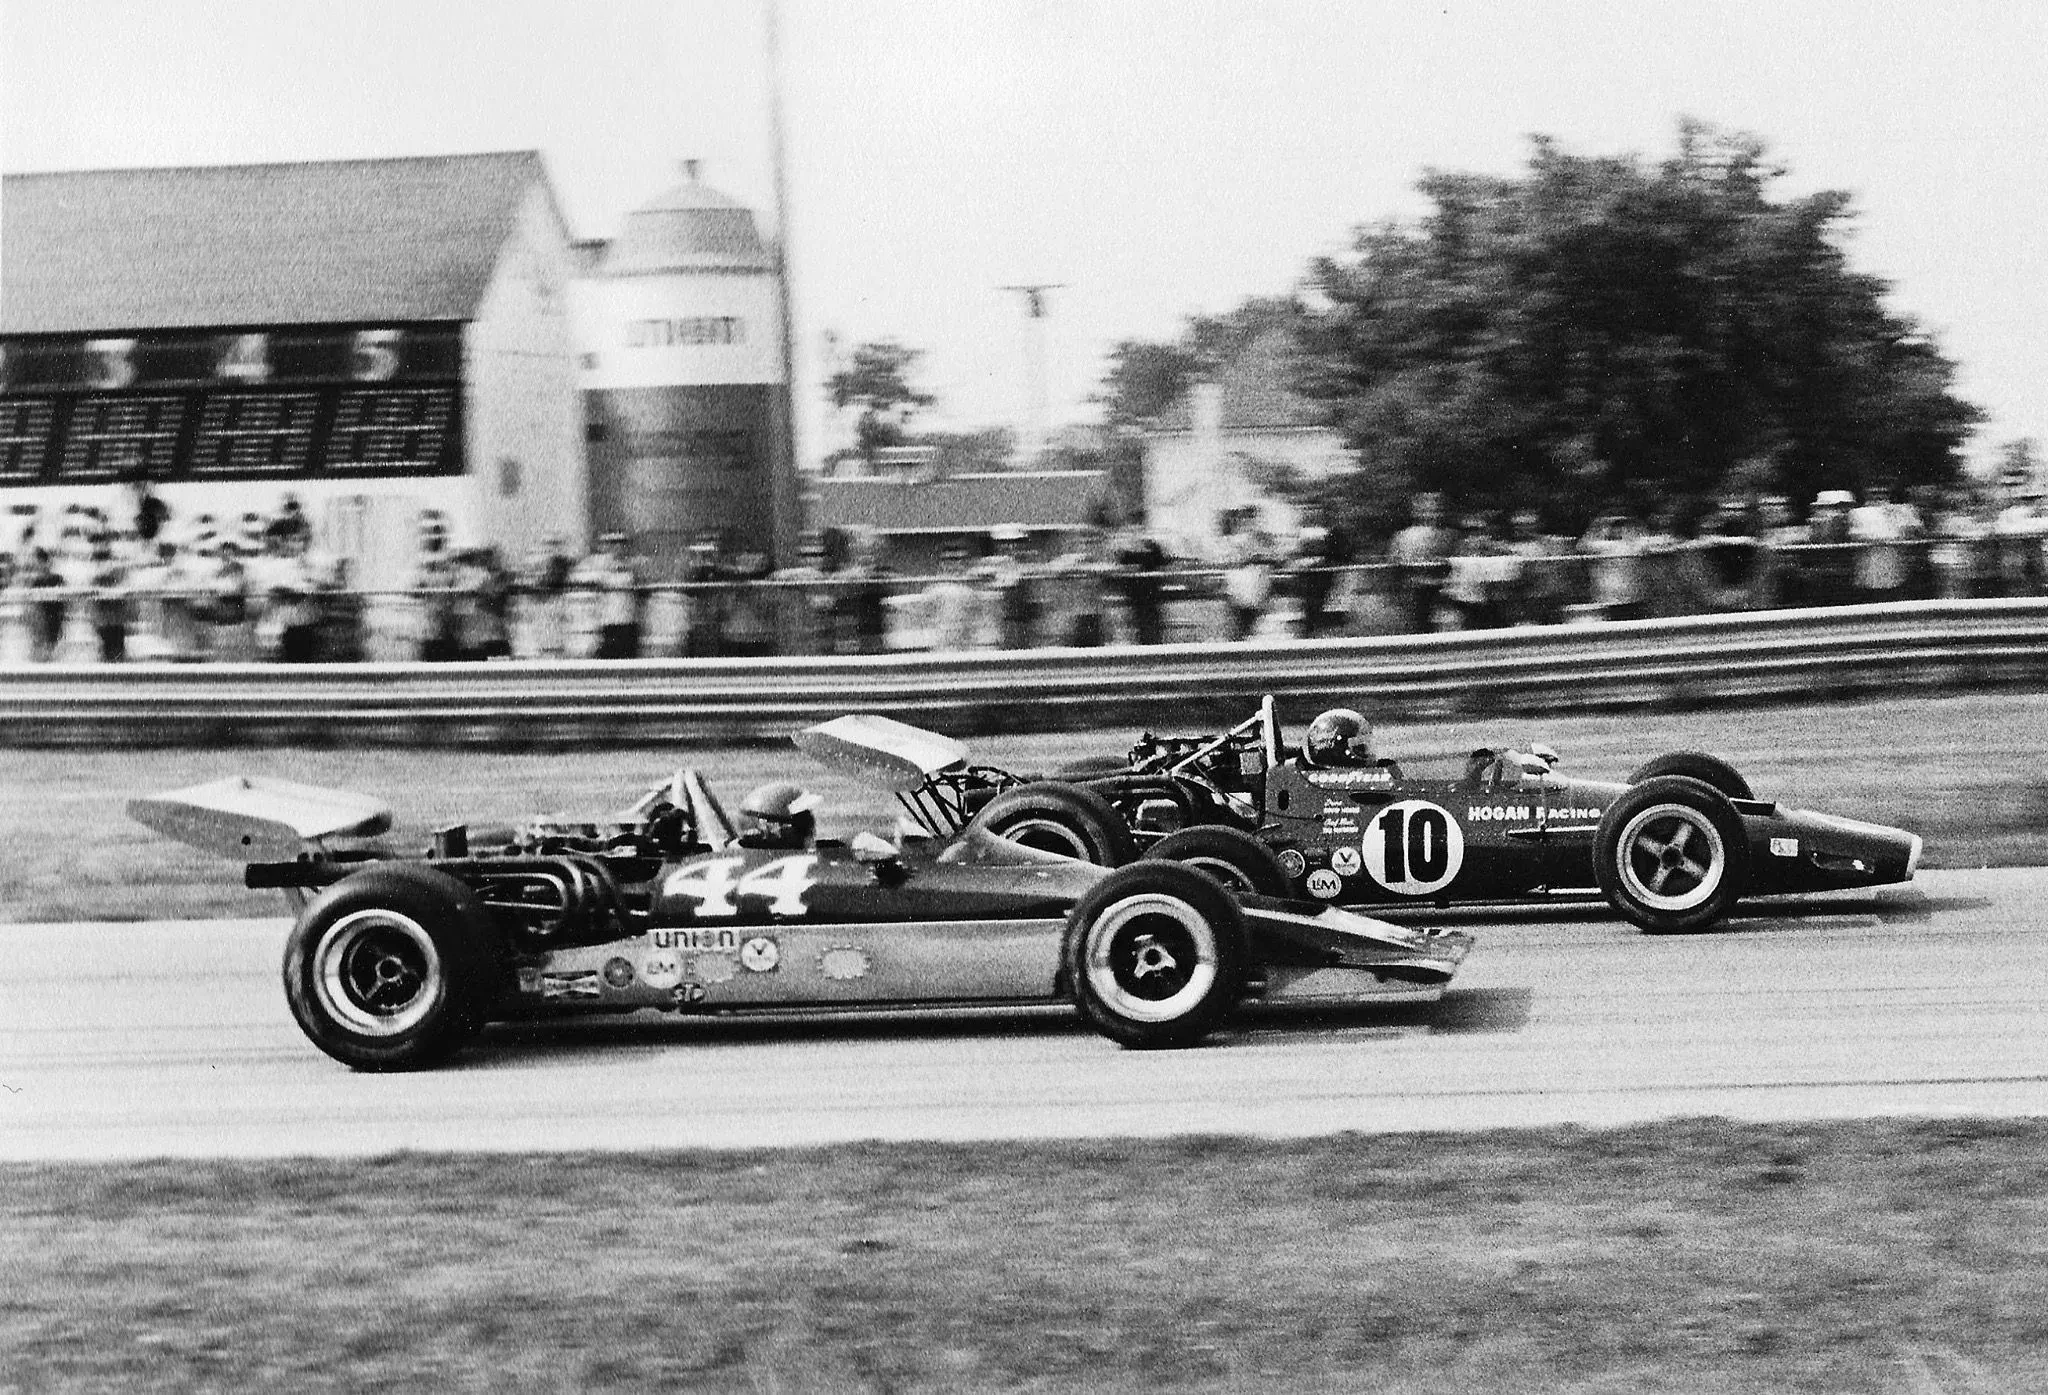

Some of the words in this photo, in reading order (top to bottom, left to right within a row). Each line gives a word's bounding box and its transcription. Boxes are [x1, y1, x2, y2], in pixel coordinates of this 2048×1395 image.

[84, 338, 136, 389] 3
[216, 333, 274, 385] 4
[355, 329, 402, 382] 5
[1468, 806, 1529, 821] HOGAN
[1535, 806, 1601, 820] RACING
[1379, 808, 1449, 884] 10
[663, 855, 818, 917] 44
